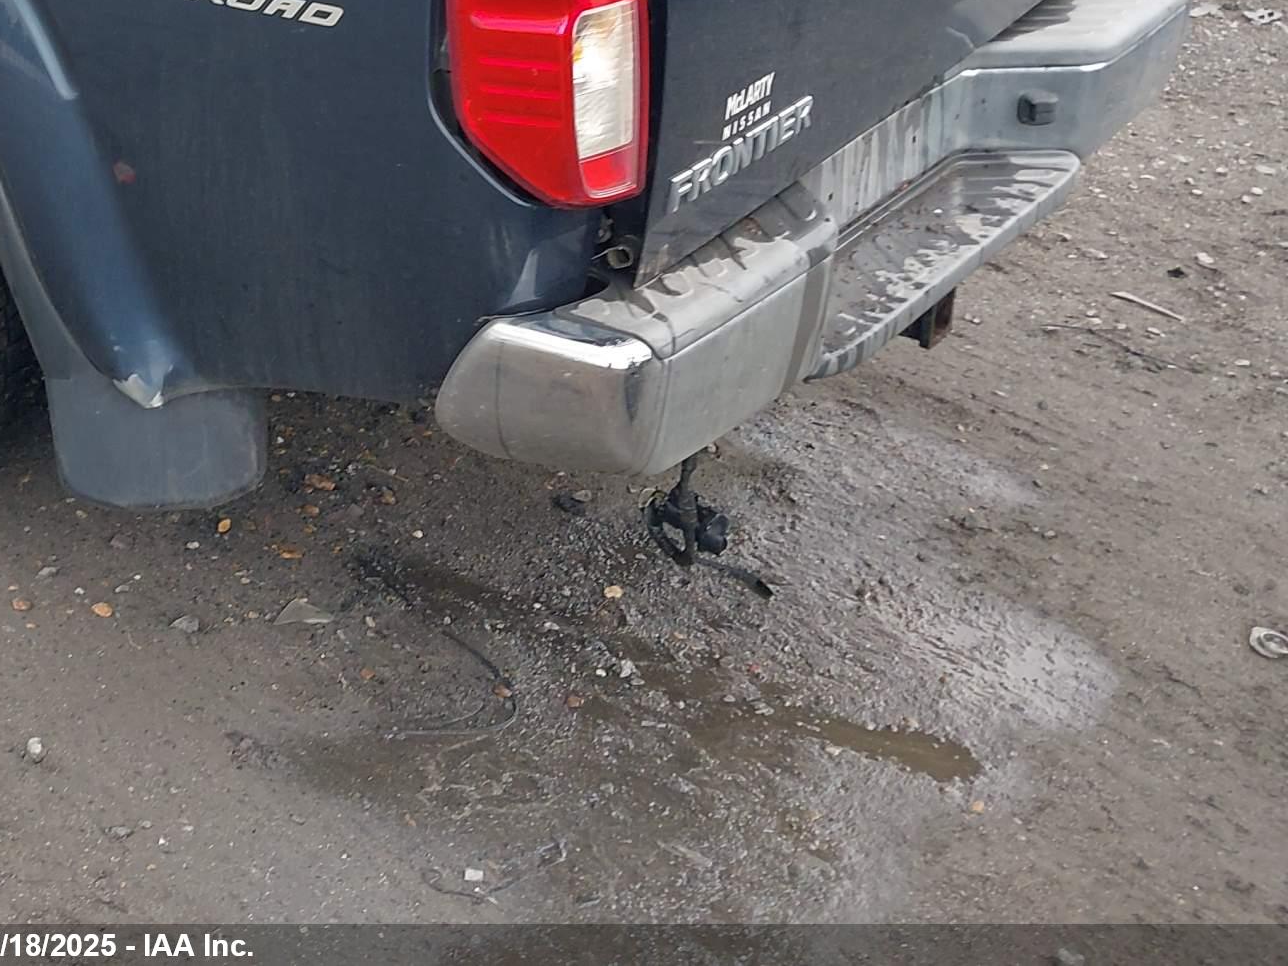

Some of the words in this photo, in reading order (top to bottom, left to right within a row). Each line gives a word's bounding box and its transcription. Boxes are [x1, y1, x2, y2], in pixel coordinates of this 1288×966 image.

[721, 100, 772, 141] NISSAN
[724, 71, 776, 121] McLARTY
[666, 94, 814, 213] FRONTIER
